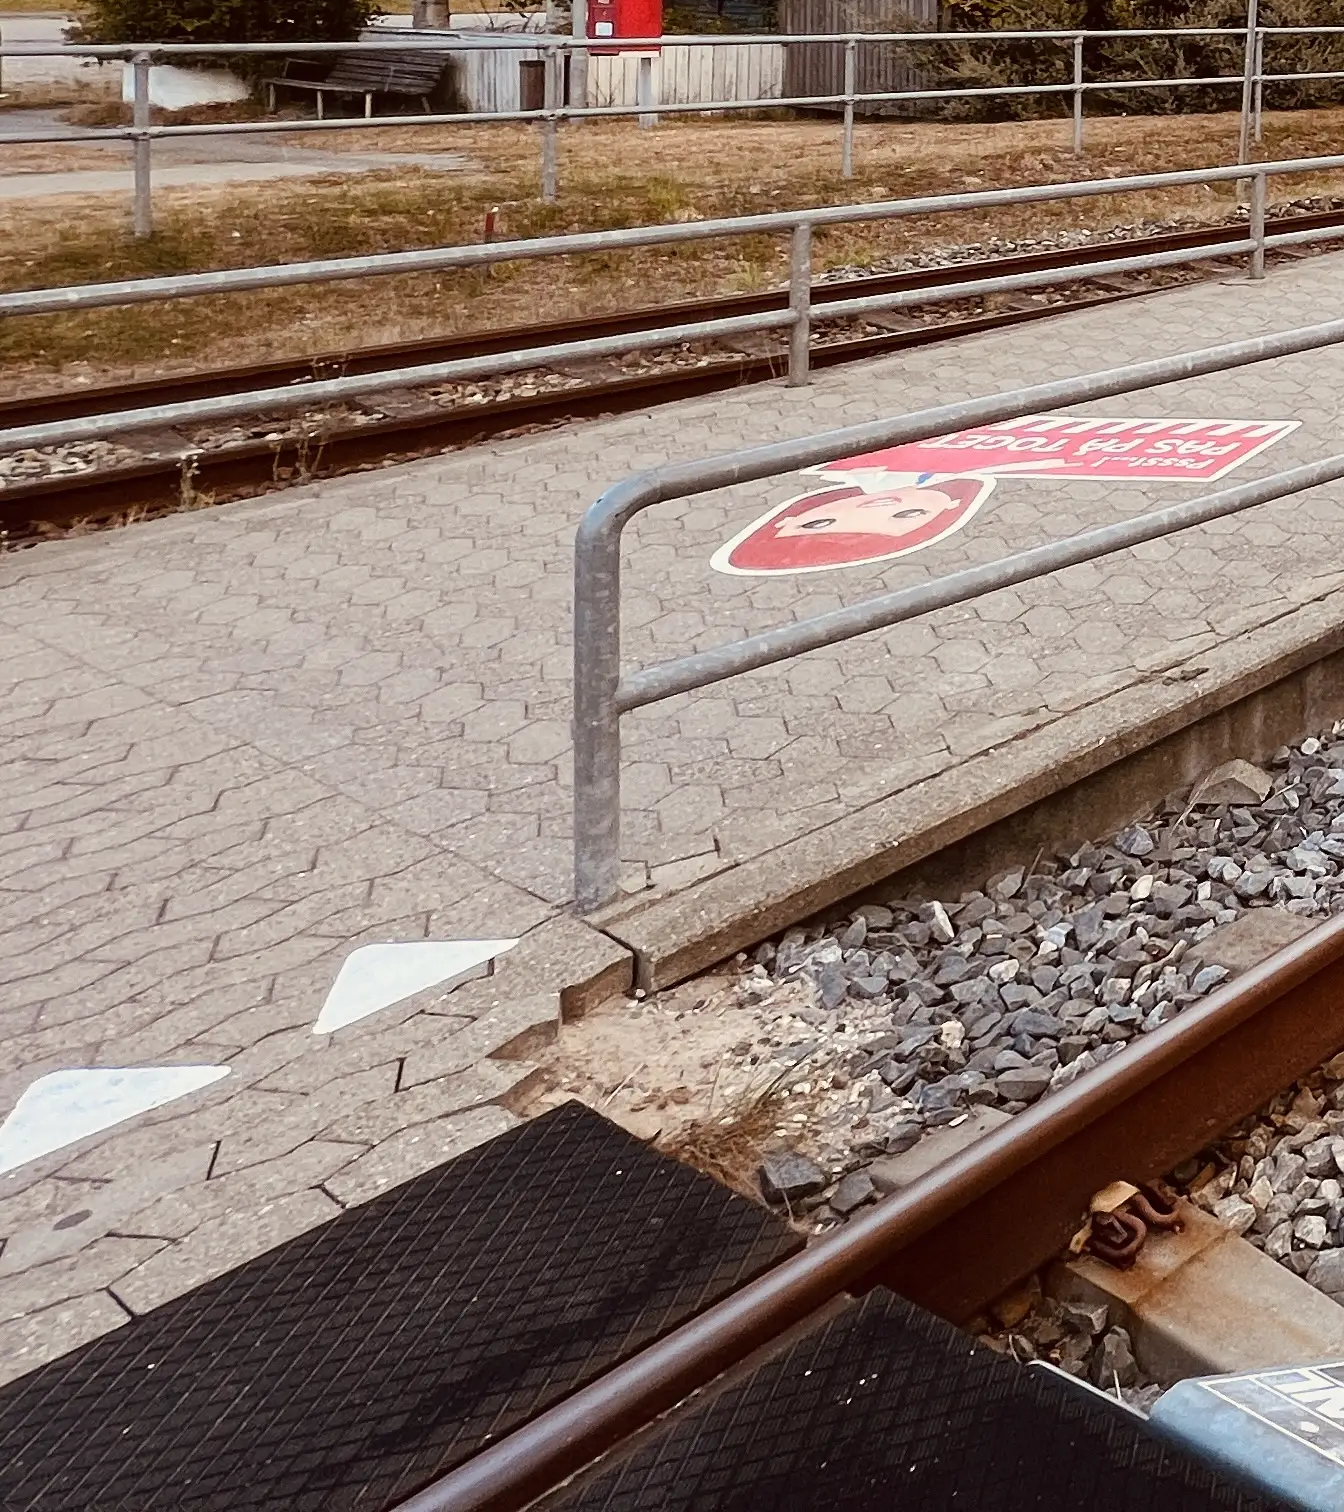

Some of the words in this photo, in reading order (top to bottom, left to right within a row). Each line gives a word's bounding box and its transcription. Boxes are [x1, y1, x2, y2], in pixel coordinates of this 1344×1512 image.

[917, 433, 1070, 453] TOGET
[1072, 438, 1145, 456] PÅ
[1145, 438, 1242, 456] PAS
